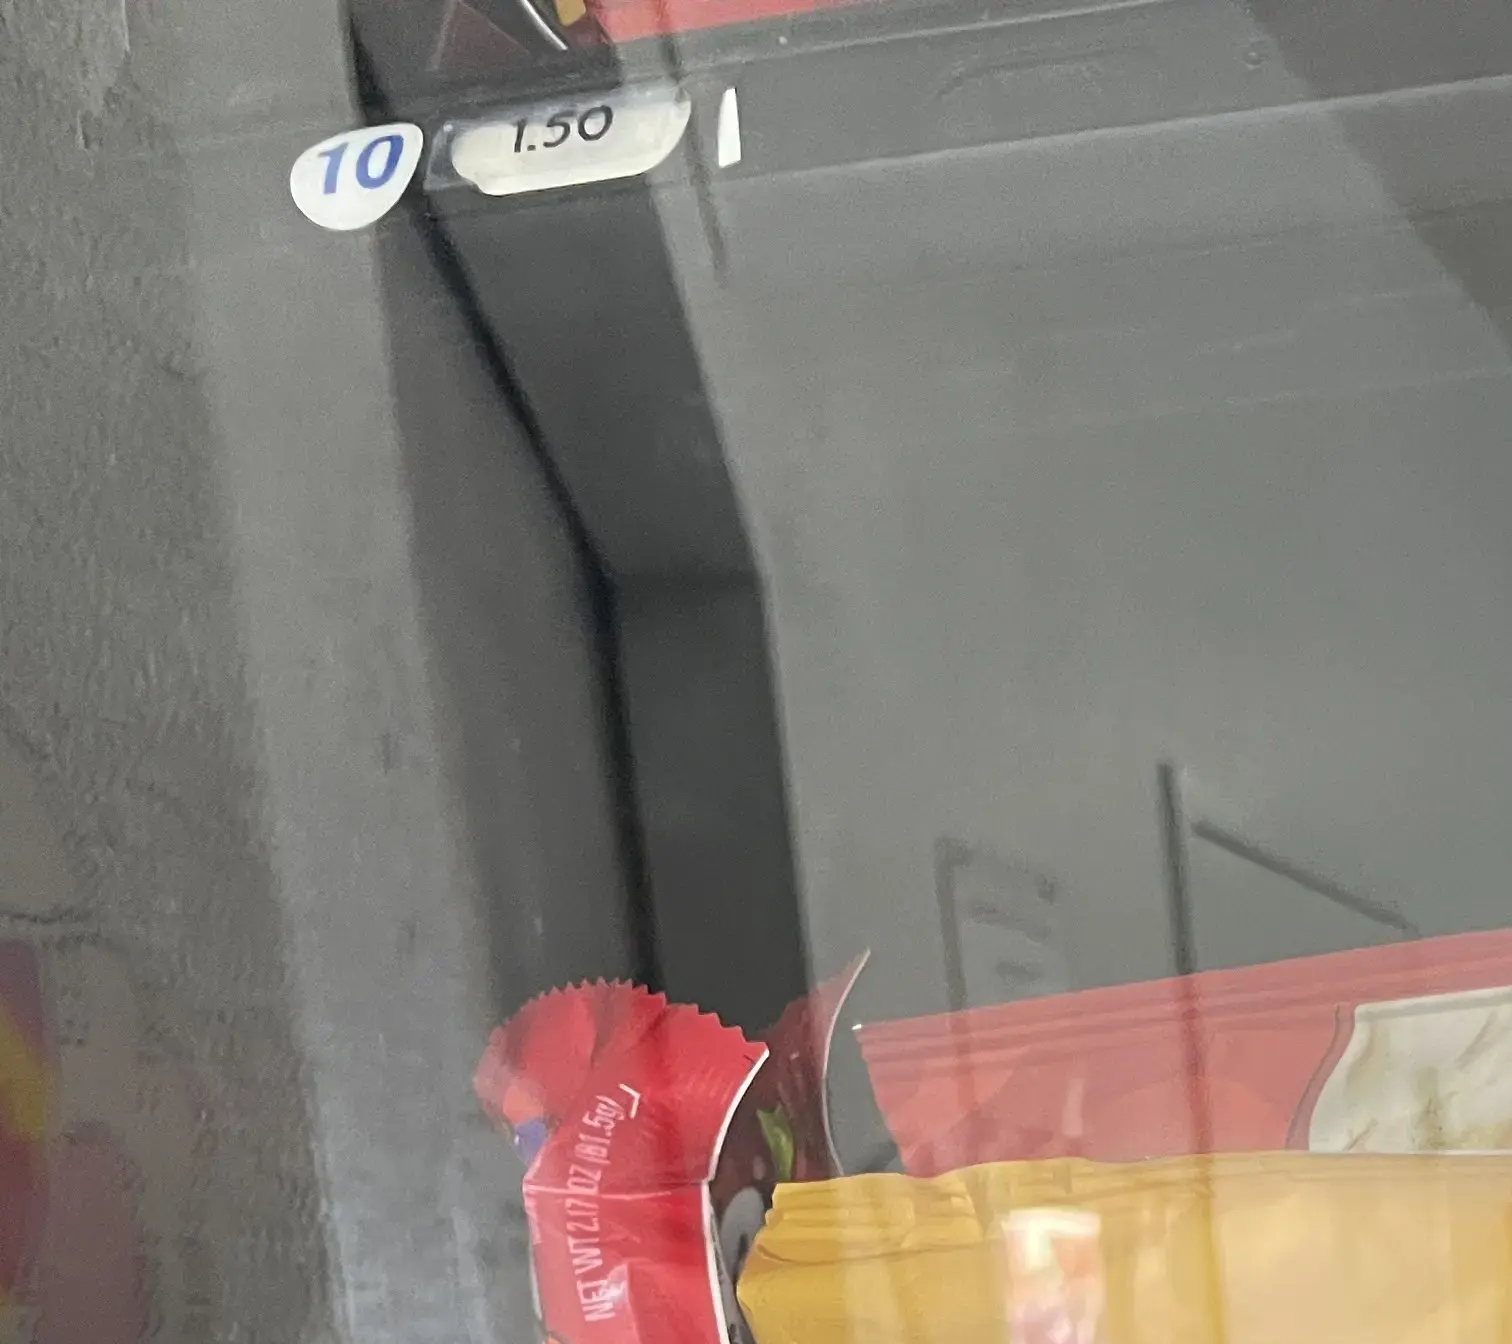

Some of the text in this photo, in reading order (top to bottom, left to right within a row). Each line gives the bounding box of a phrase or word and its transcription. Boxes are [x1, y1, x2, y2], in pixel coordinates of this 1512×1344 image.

[511, 105, 614, 154] 1.50
[318, 134, 402, 196] 10
[566, 1163, 602, 1194] OZ
[564, 1198, 599, 1233] 2.17
[568, 1236, 601, 1275] WT
[577, 1276, 615, 1322] NET
